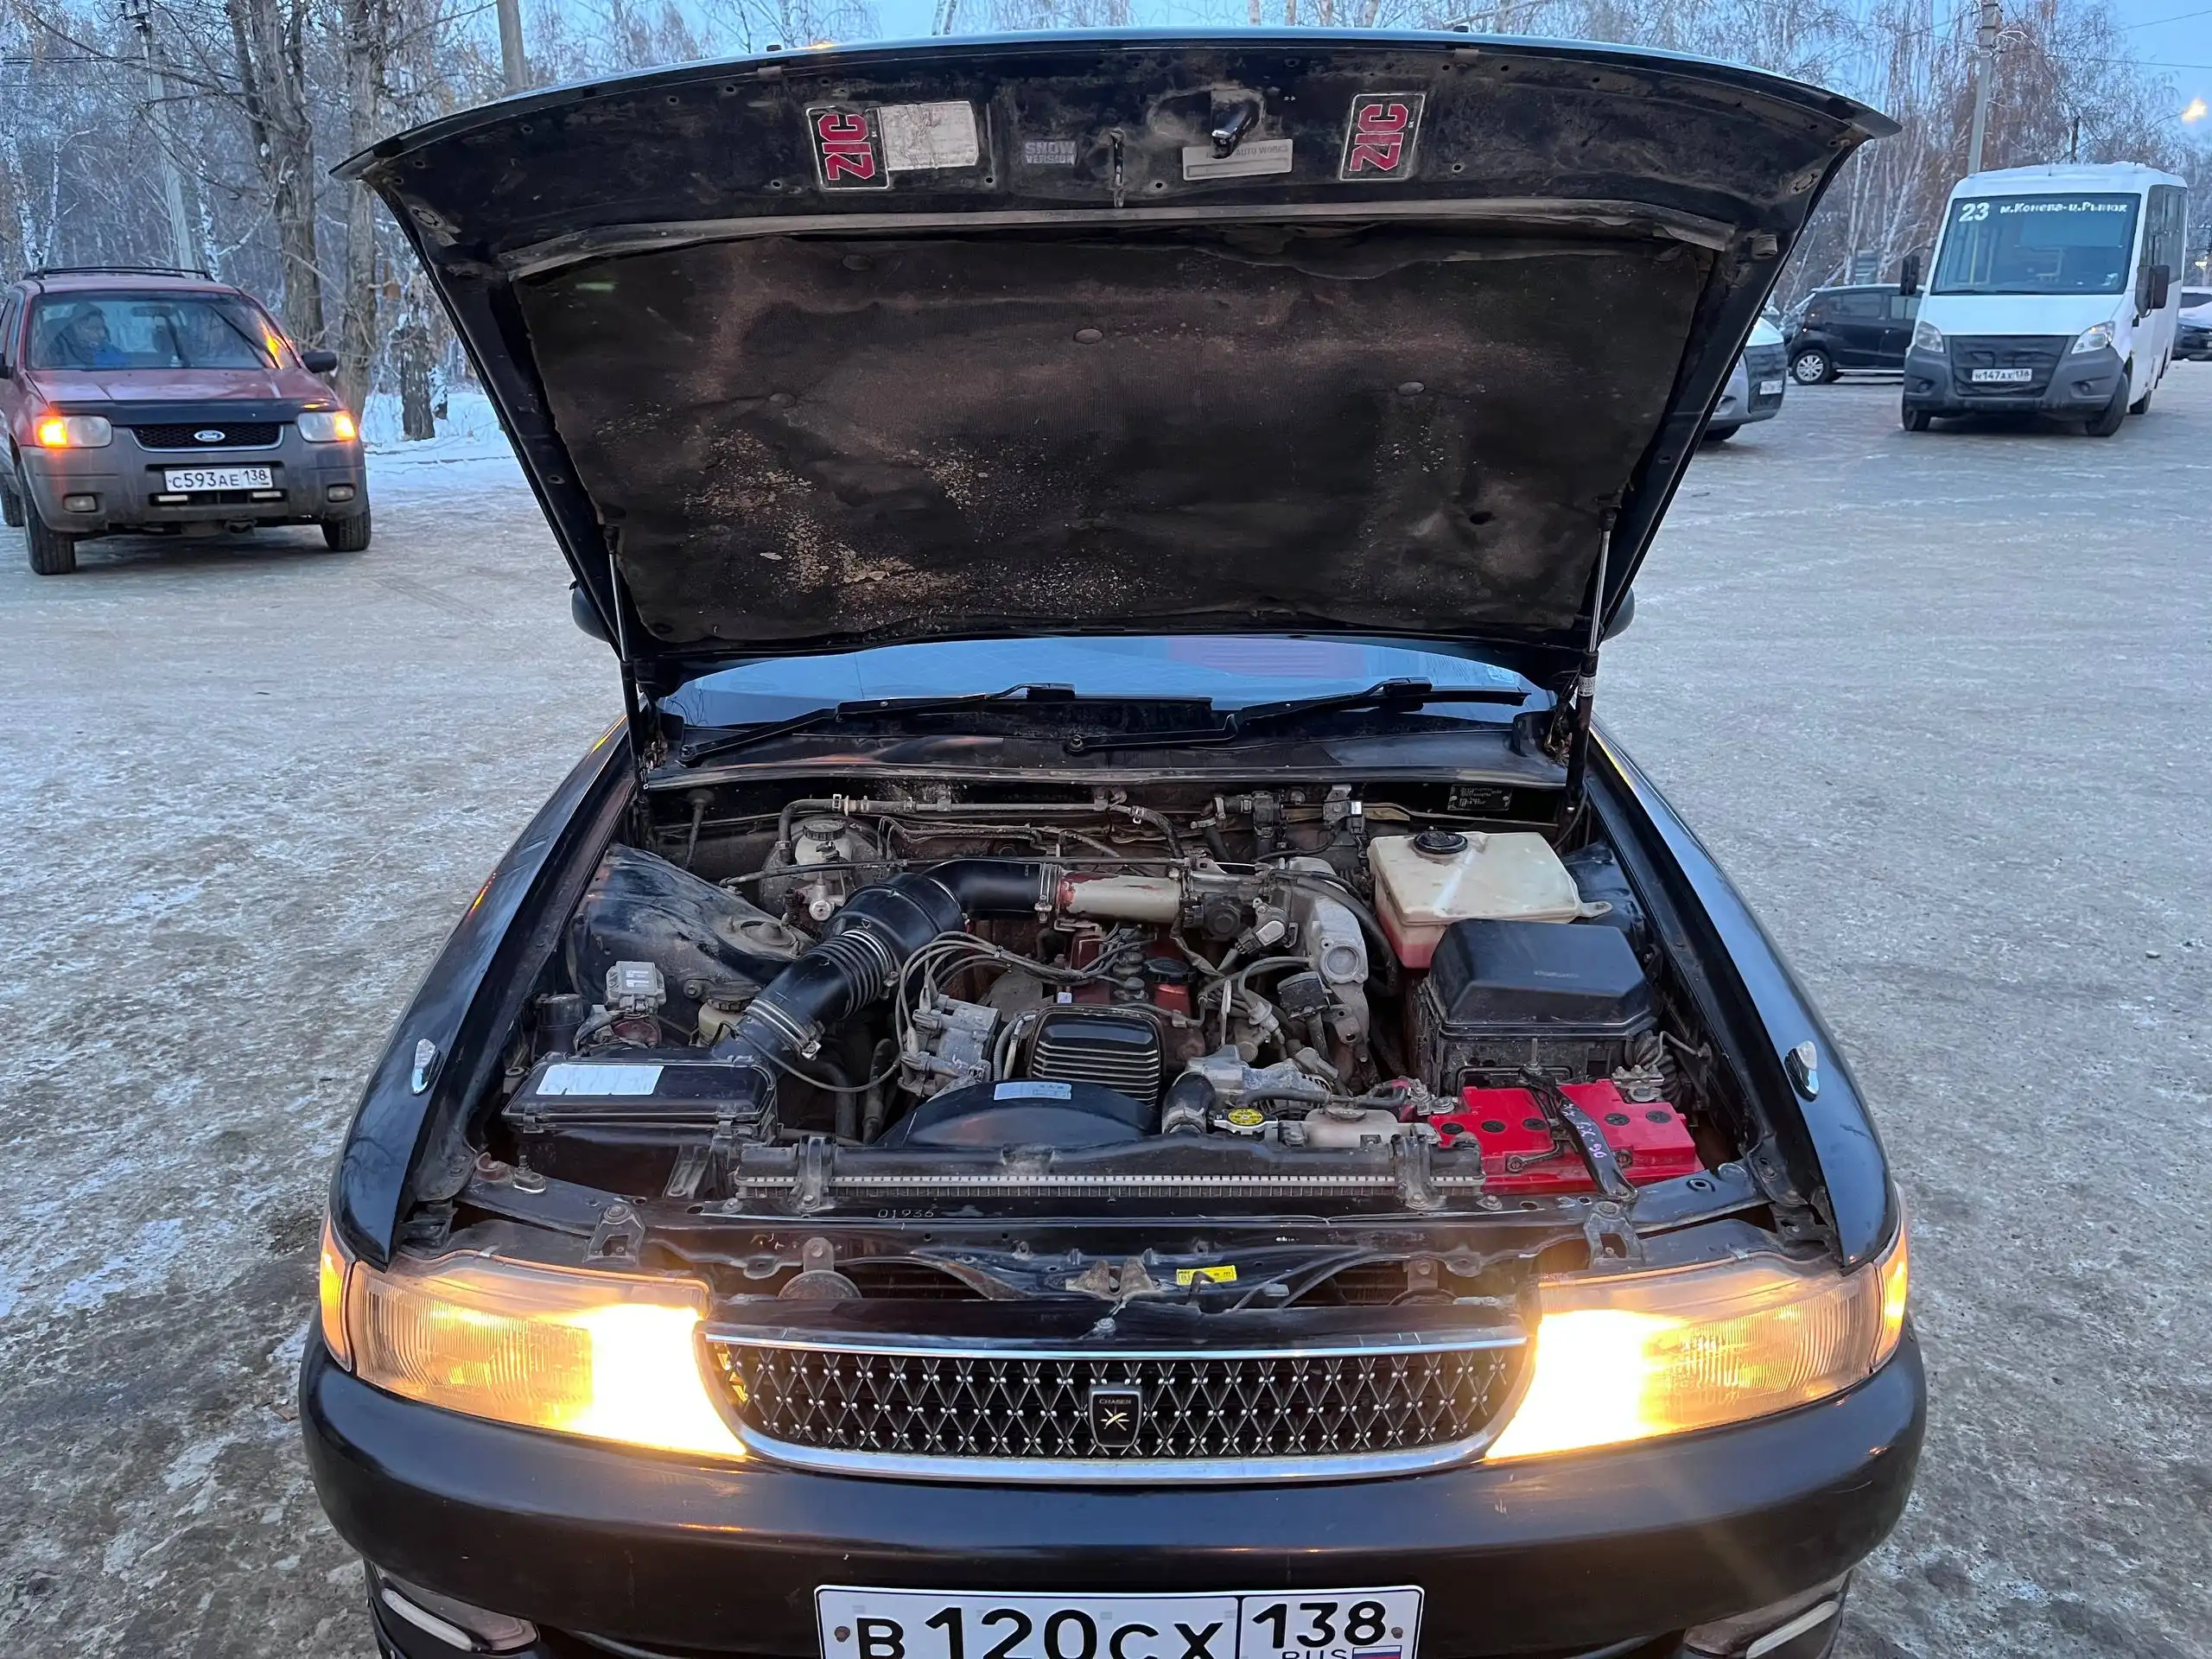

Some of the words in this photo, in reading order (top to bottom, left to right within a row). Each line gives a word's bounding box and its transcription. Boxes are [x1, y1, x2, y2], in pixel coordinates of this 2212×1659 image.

[1349, 103, 1409, 171] ZIC
[817, 113, 875, 180] ZIC
[1025, 141, 1077, 154] SNOW
[1236, 147, 1257, 156] AUTO
[1026, 154, 1076, 165] VERSION
[1958, 201, 1990, 222] 23
[243, 469, 267, 481] 138
[1252, 1600, 1386, 1649] 138
[1281, 1648, 1348, 1659] RUS
